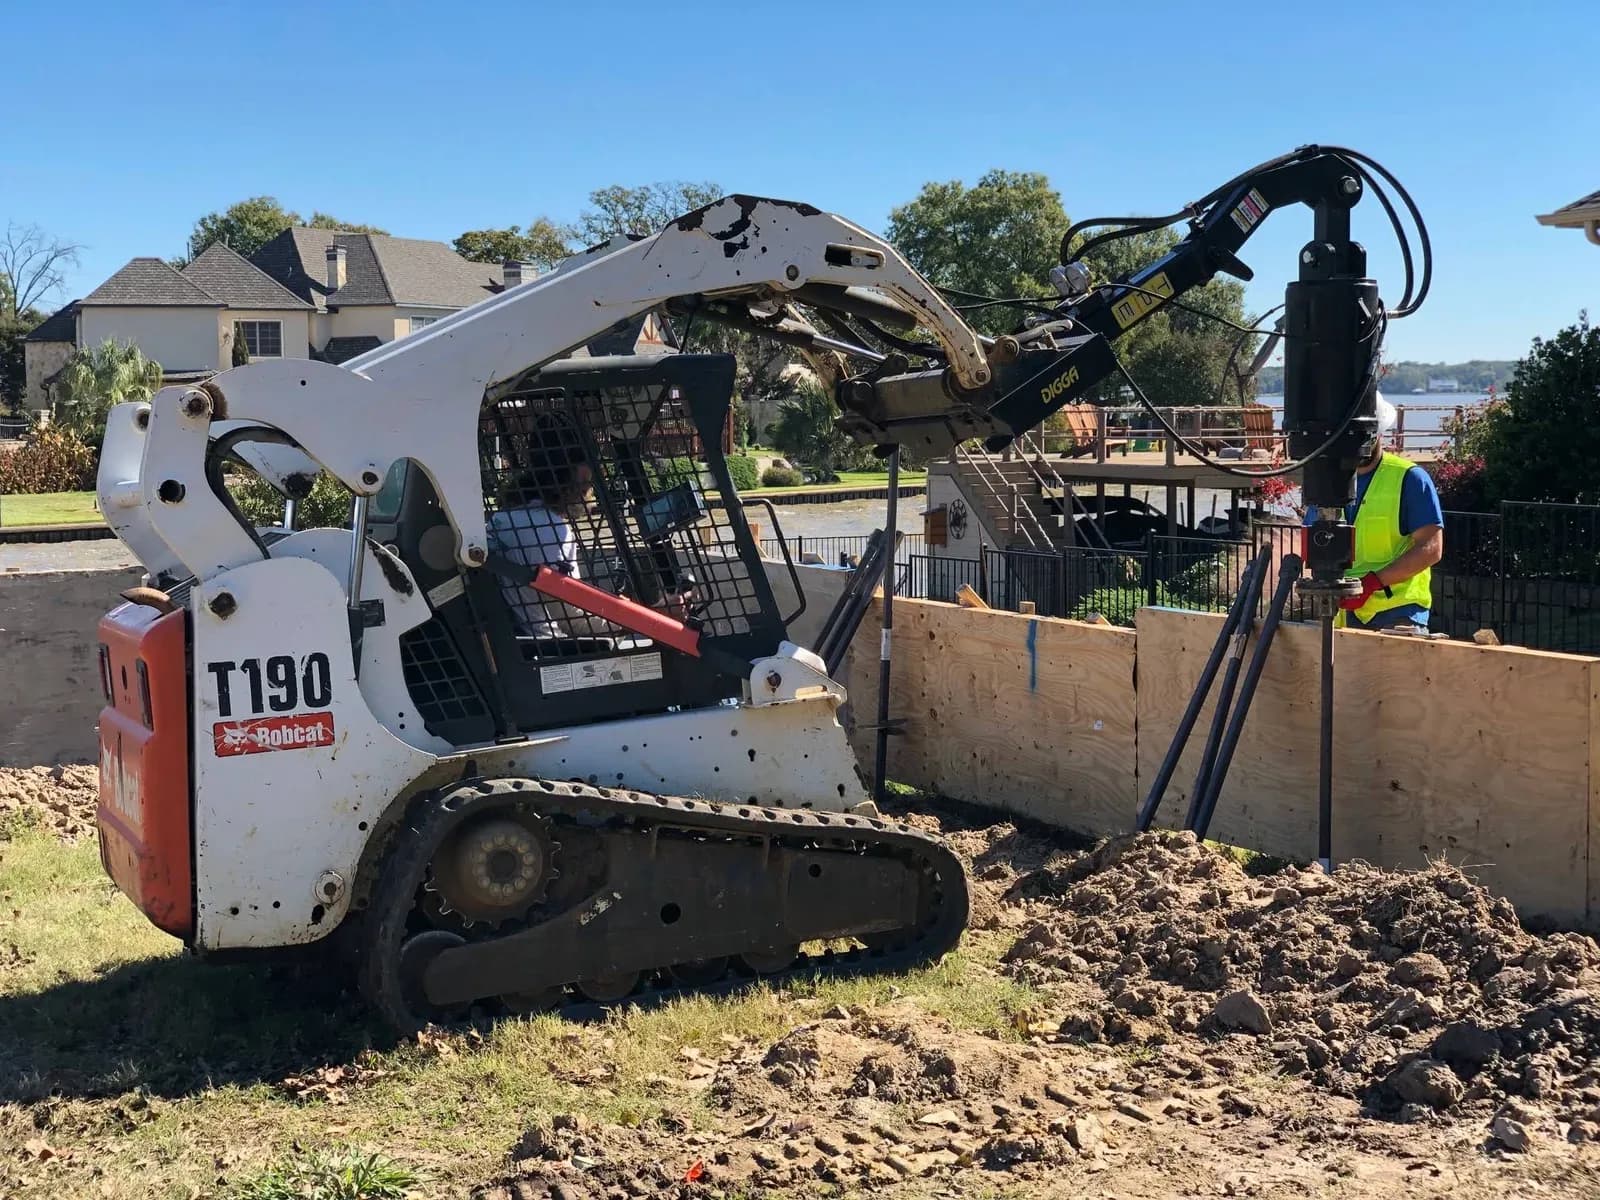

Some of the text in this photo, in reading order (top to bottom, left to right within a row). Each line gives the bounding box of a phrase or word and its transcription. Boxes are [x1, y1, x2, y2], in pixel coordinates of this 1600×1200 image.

[1041, 365, 1079, 404] DIGGA
[208, 652, 332, 717] T190
[256, 722, 325, 747] Bobcat
